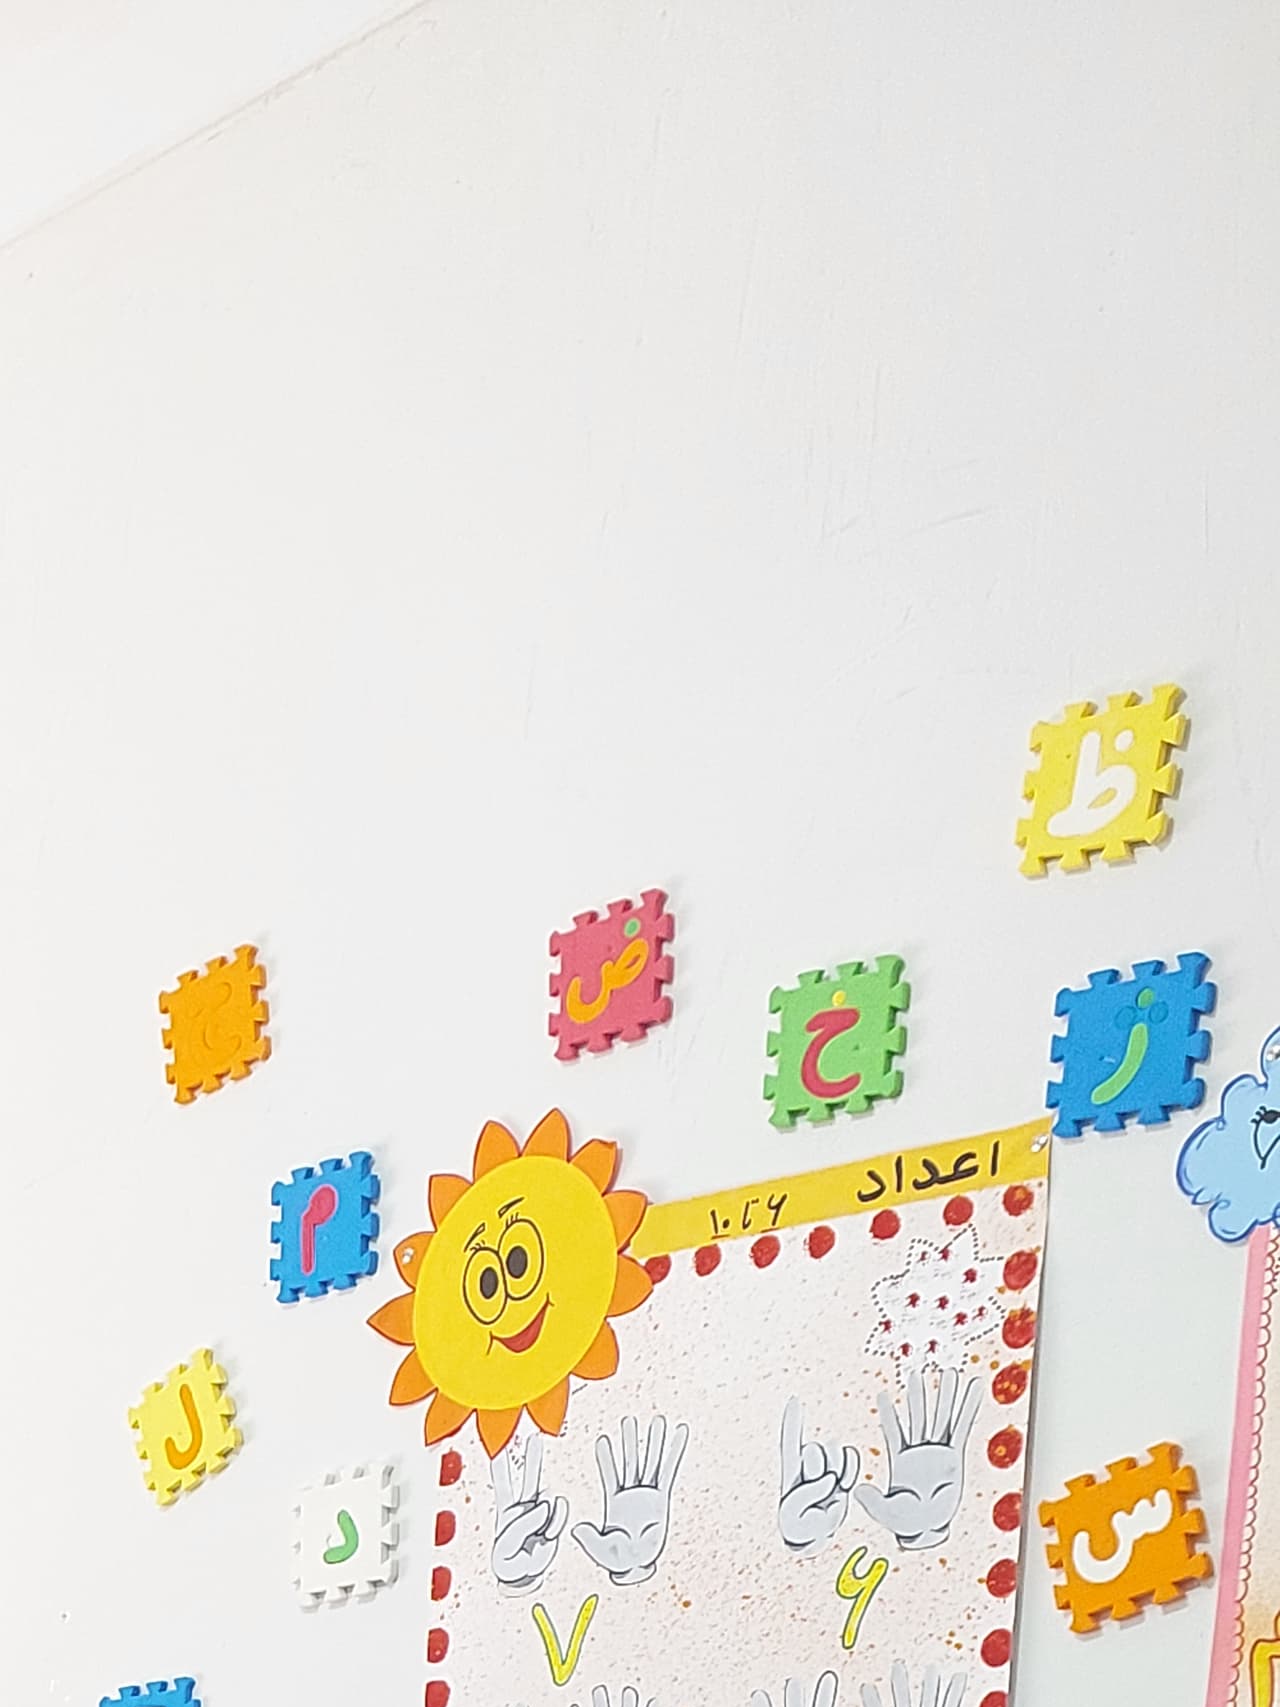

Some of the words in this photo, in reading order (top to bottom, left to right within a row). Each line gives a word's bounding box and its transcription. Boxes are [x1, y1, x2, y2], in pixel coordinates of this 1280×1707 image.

[1046, 730, 1135, 839] ظ
[566, 918, 649, 1024] ض
[800, 989, 861, 1099] خ
[856, 1140, 1000, 1203] اعداد
[165, 1383, 203, 1470] ل
[323, 1509, 359, 1564] د
[1072, 1488, 1174, 1584] س
[532, 1593, 599, 1687] ۷
